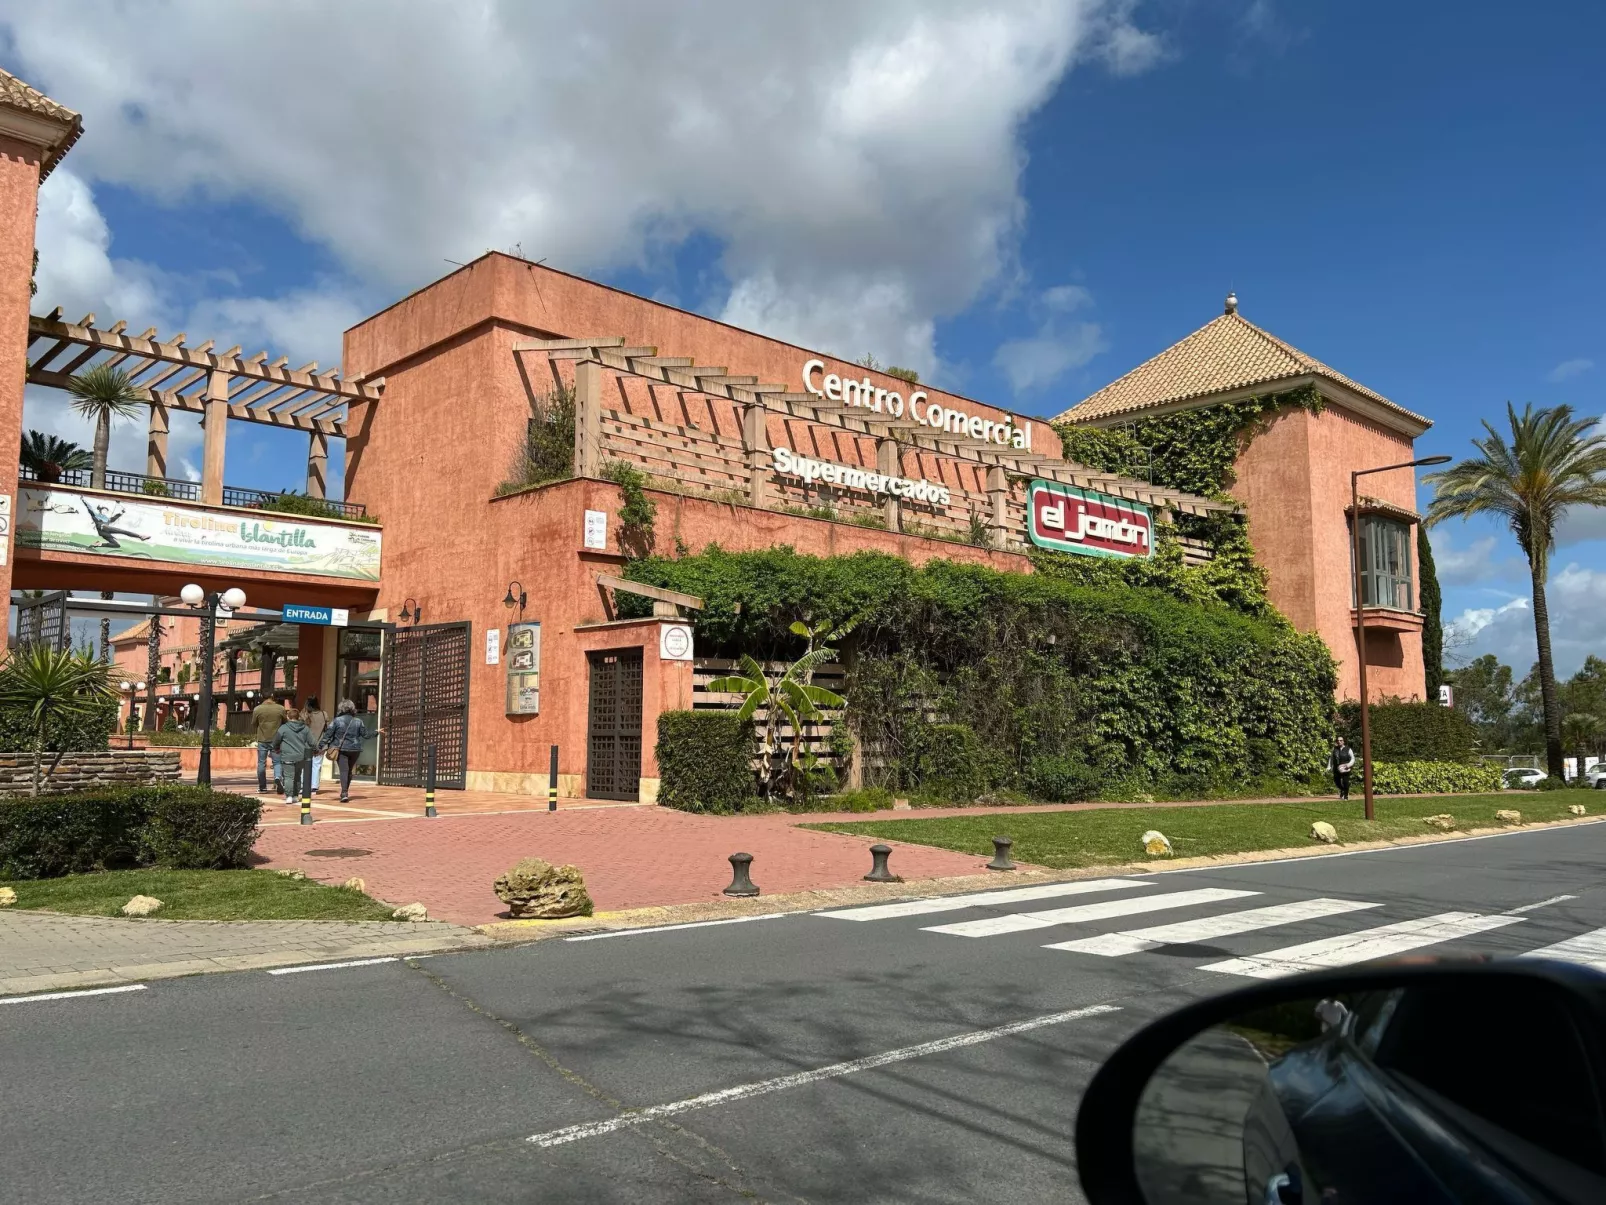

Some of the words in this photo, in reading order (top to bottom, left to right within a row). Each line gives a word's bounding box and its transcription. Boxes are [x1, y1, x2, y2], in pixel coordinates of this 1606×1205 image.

[802, 359, 904, 418] Centro
[909, 391, 1031, 453] Comercial
[772, 447, 950, 505] Supermercados
[163, 511, 238, 533] Tirolina
[240, 522, 316, 548] Islantilla
[1041, 501, 1064, 529] el
[201, 539, 224, 548] tirolina
[225, 541, 247, 550] urbana
[287, 548, 308, 556] Europa
[286, 608, 328, 621] ENTRADA
